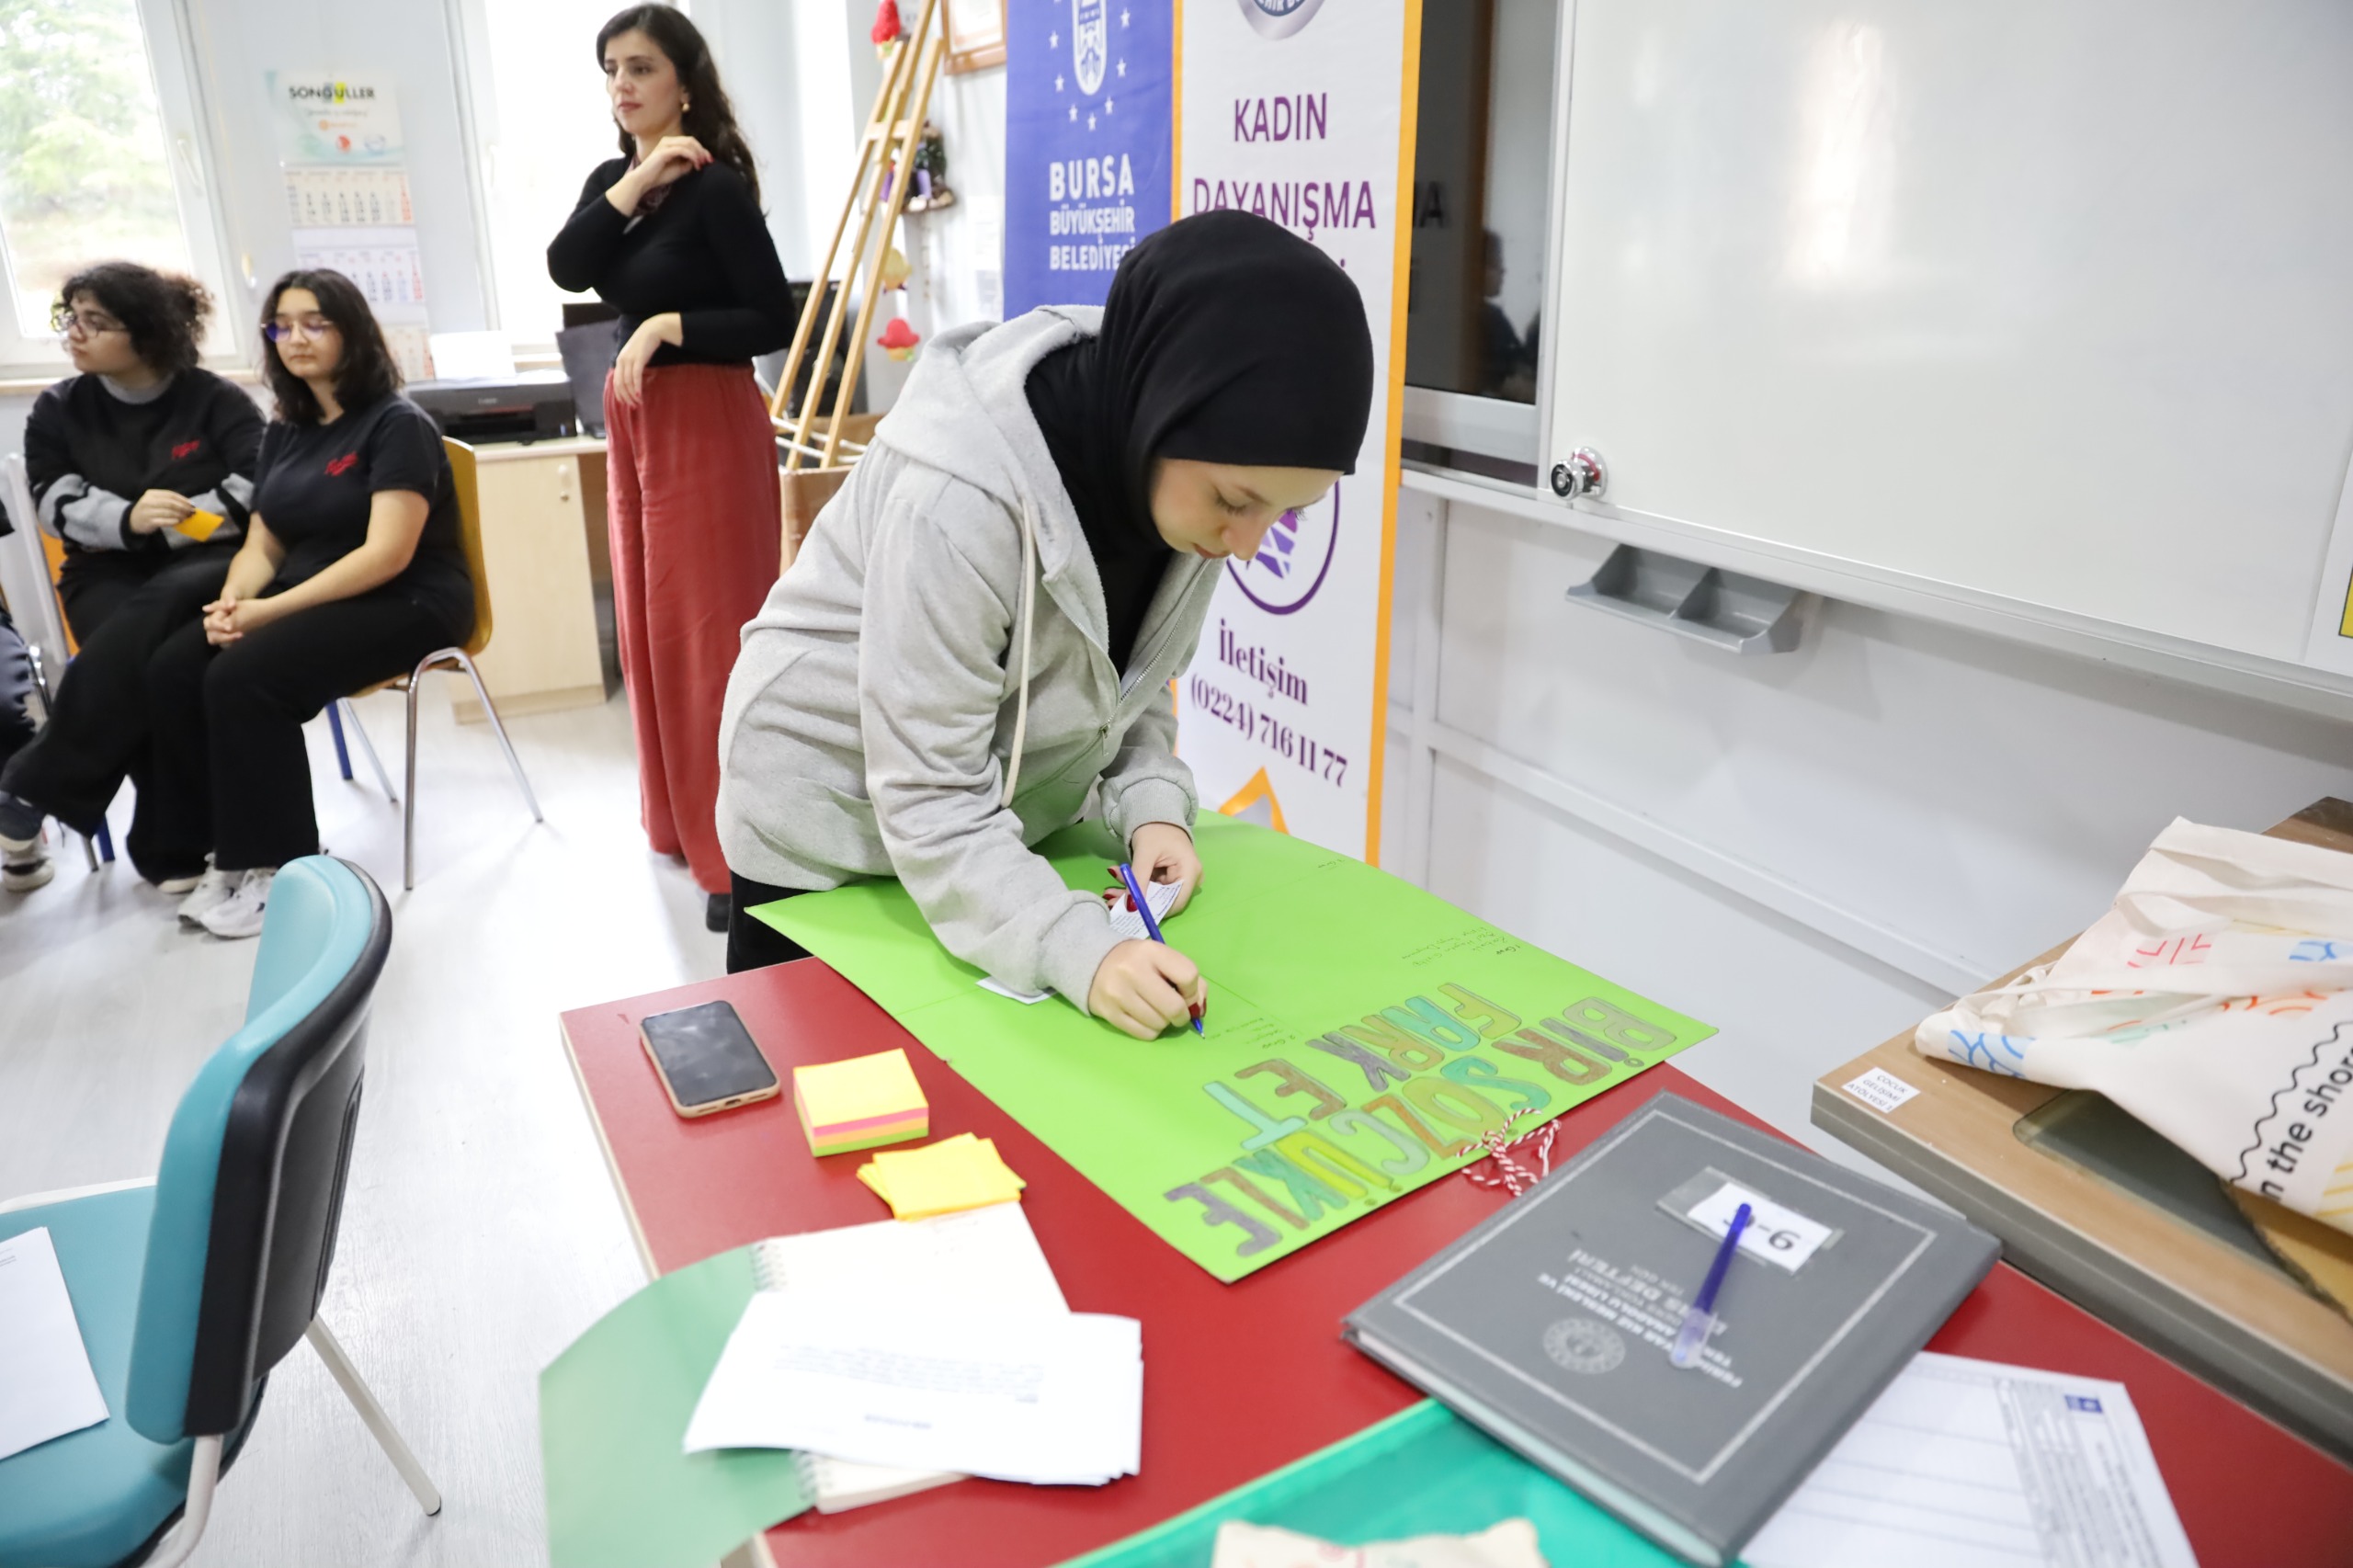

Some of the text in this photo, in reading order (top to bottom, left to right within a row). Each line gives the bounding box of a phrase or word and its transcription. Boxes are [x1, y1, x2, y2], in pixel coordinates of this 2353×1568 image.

[1234, 93, 1326, 142] KADIN
[1050, 153, 1134, 201] BURSA
[1194, 178, 1376, 241] DAYANIŞMA
[1050, 199, 1135, 239] BÜYÜKŞEHİR
[1220, 618, 1308, 706] İletişim
[1191, 673, 1347, 788] (0224) 716 11 77
[1201, 983, 1522, 1151] FARK ET
[2267, 1122, 2313, 1175] the
[2303, 1046, 2353, 1118] shor
